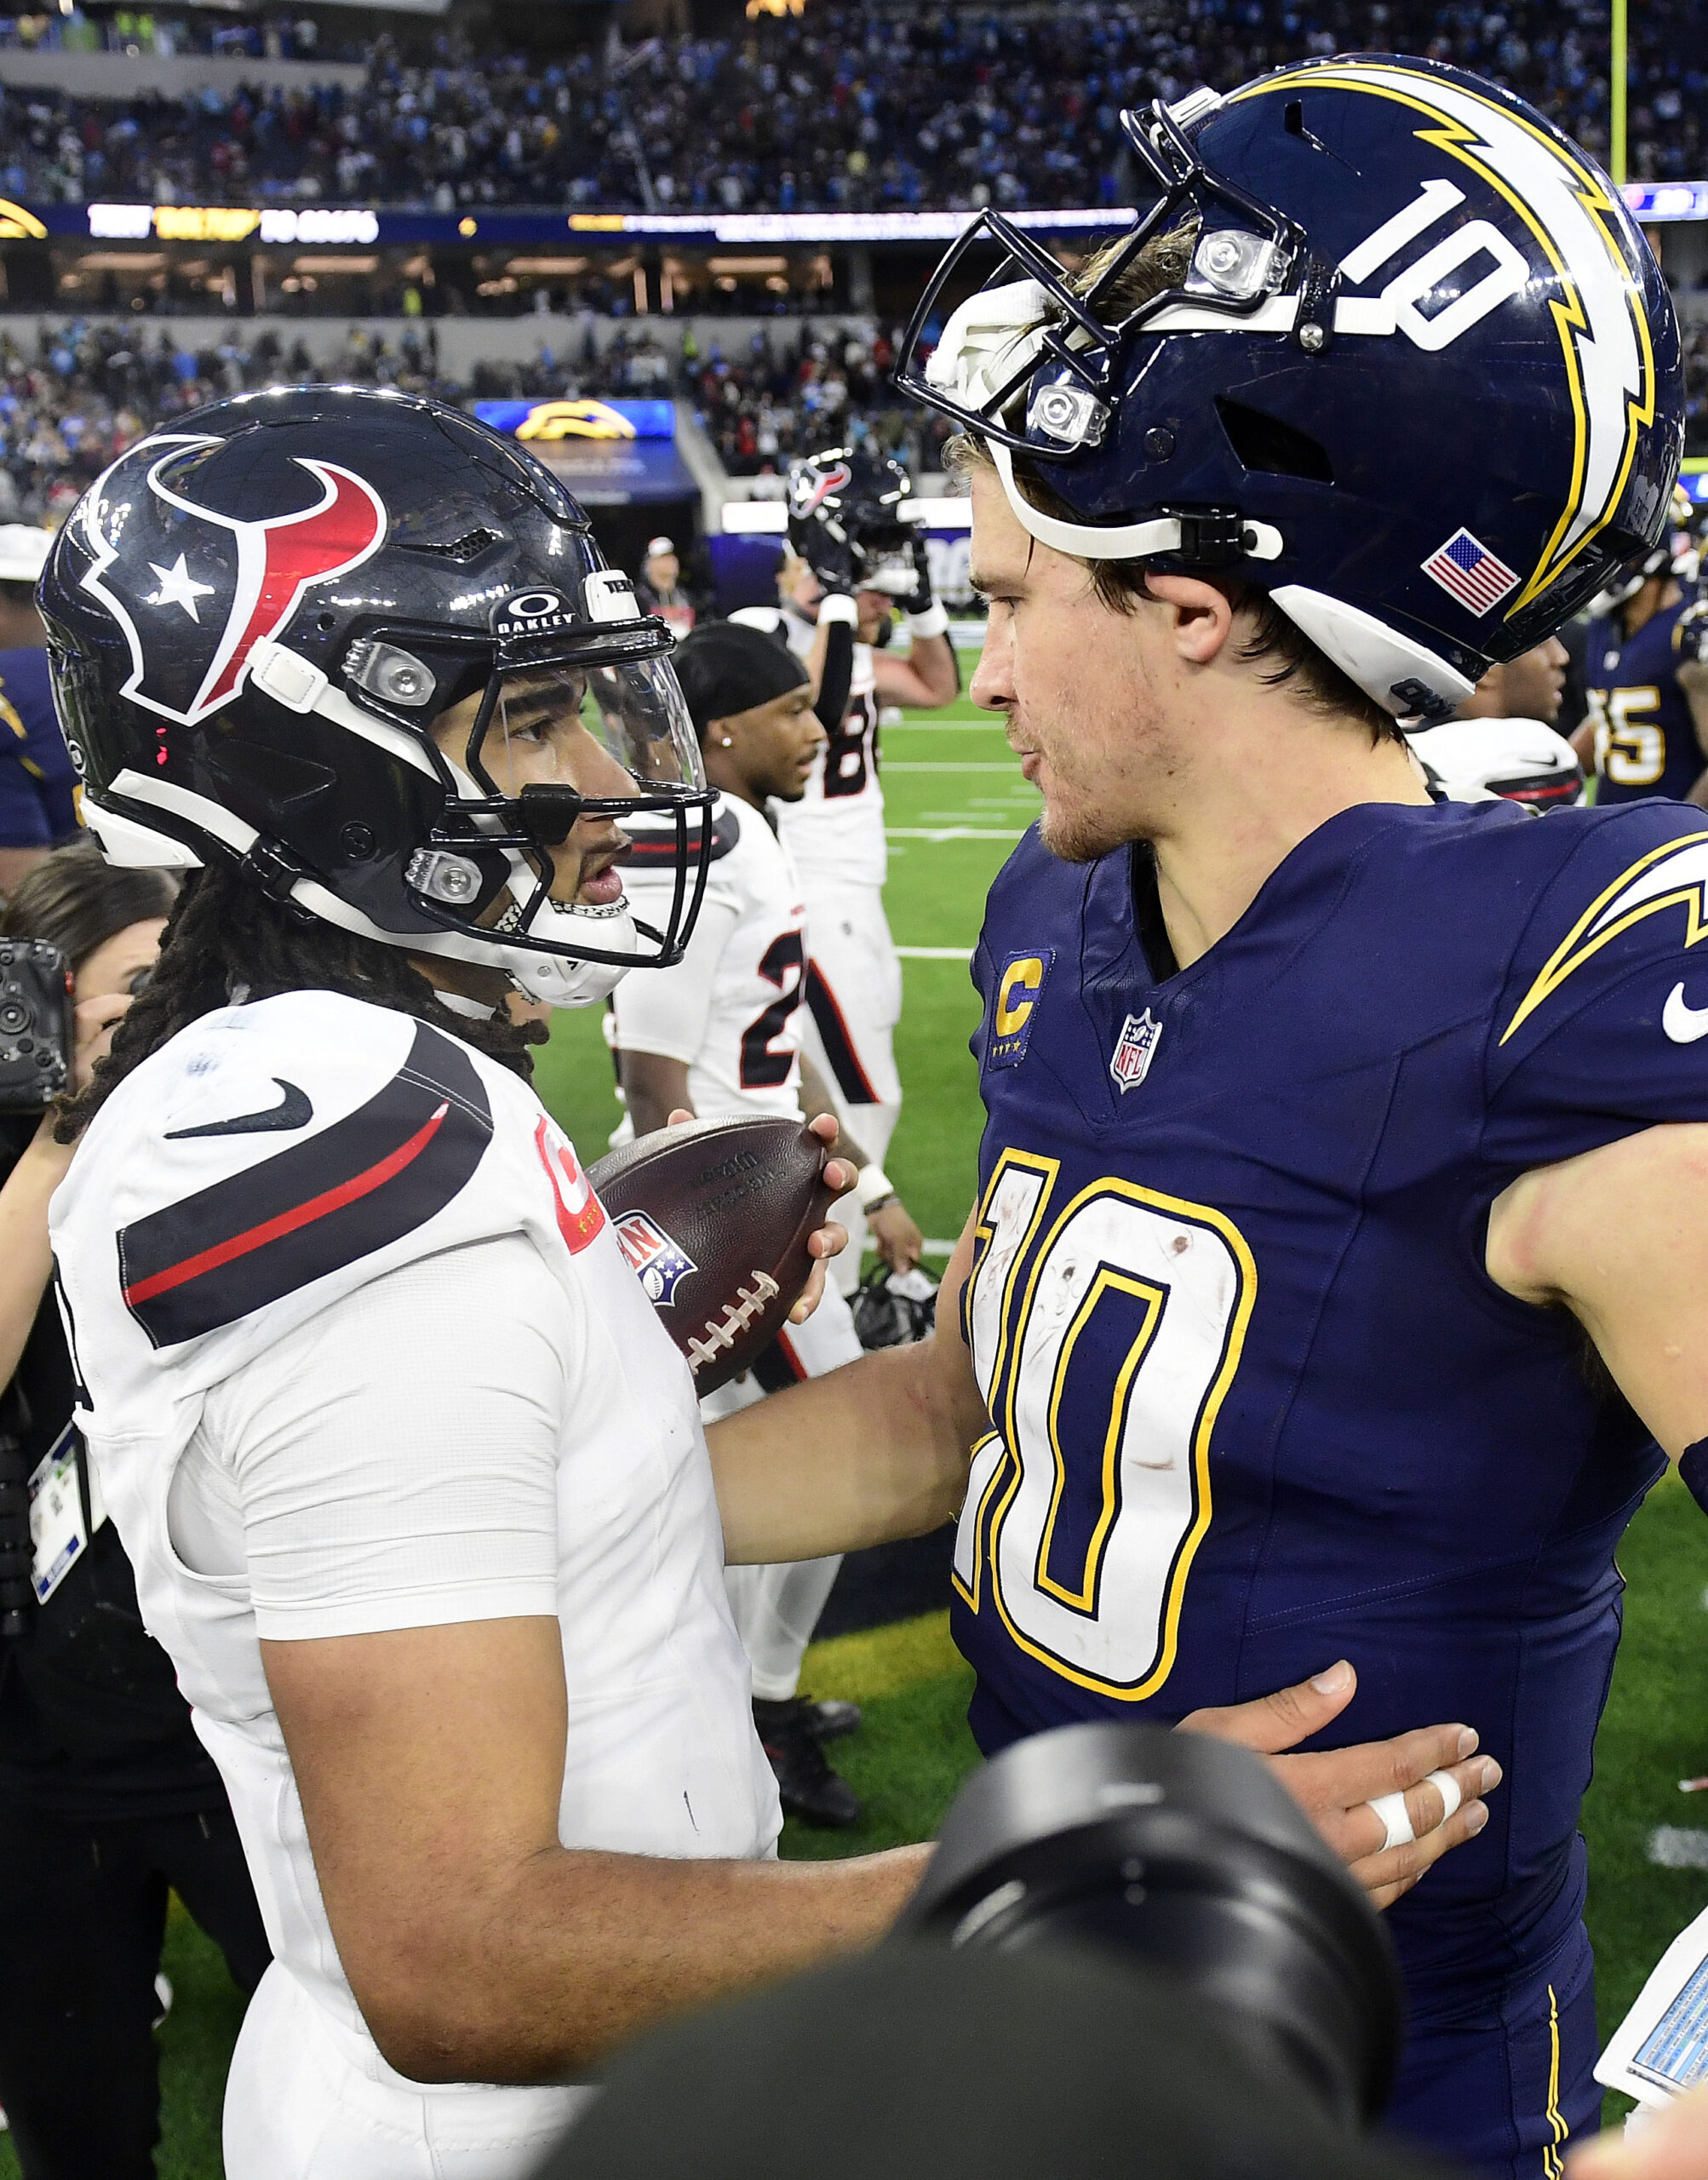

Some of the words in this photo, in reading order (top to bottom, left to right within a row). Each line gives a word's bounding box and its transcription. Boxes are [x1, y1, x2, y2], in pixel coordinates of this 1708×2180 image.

[1338, 179, 1530, 351] 10
[497, 613, 576, 634] OAKLEY
[740, 928, 802, 1089] 2
[995, 957, 1043, 1037] C
[1116, 1044, 1143, 1077] NFL
[951, 1146, 1258, 1701] 10
